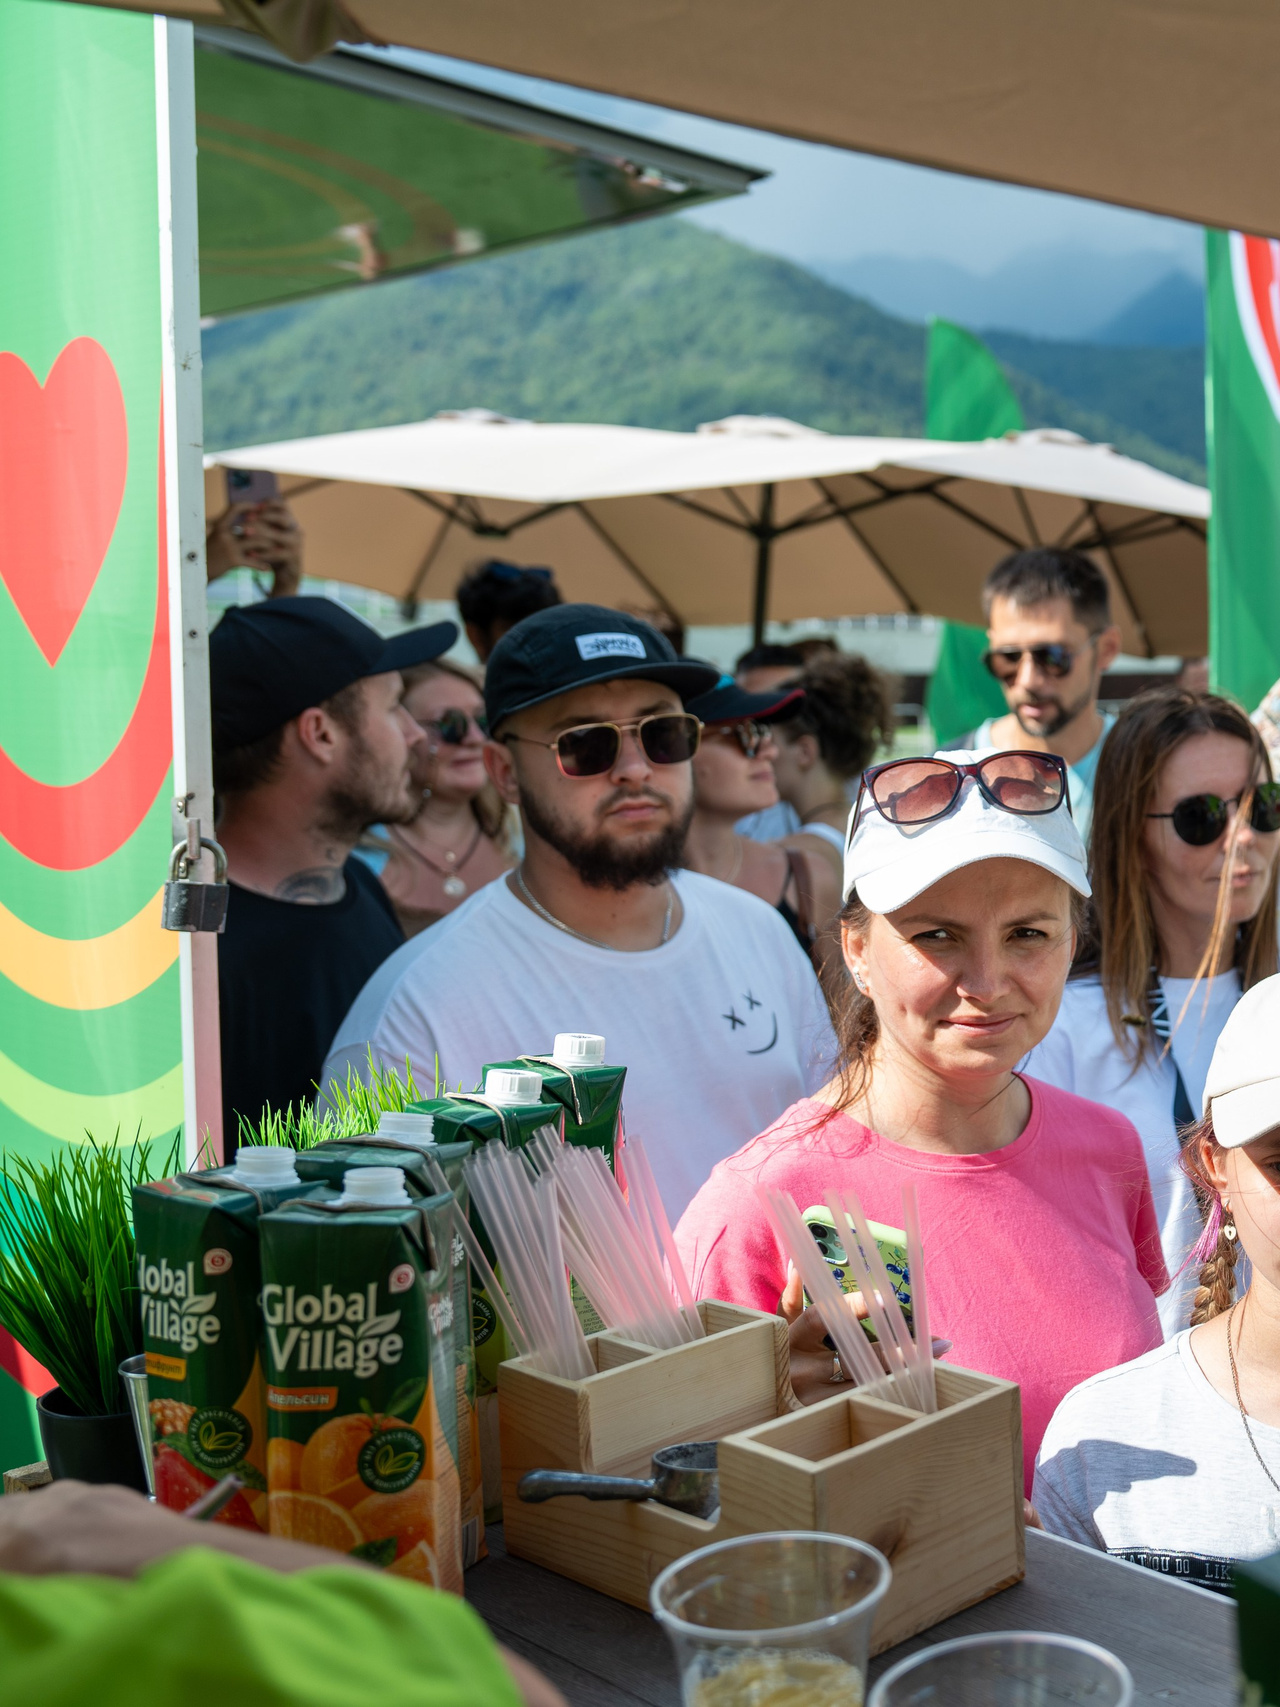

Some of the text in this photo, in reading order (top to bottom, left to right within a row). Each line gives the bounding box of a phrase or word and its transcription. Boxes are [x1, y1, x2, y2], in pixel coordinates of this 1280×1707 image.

[137, 1252, 195, 1298] lobal
[263, 1282, 379, 1326] Global
[267, 1326, 404, 1379] Village
[1175, 1558, 1190, 1574] DO
[1205, 1562, 1236, 1580] LIK
